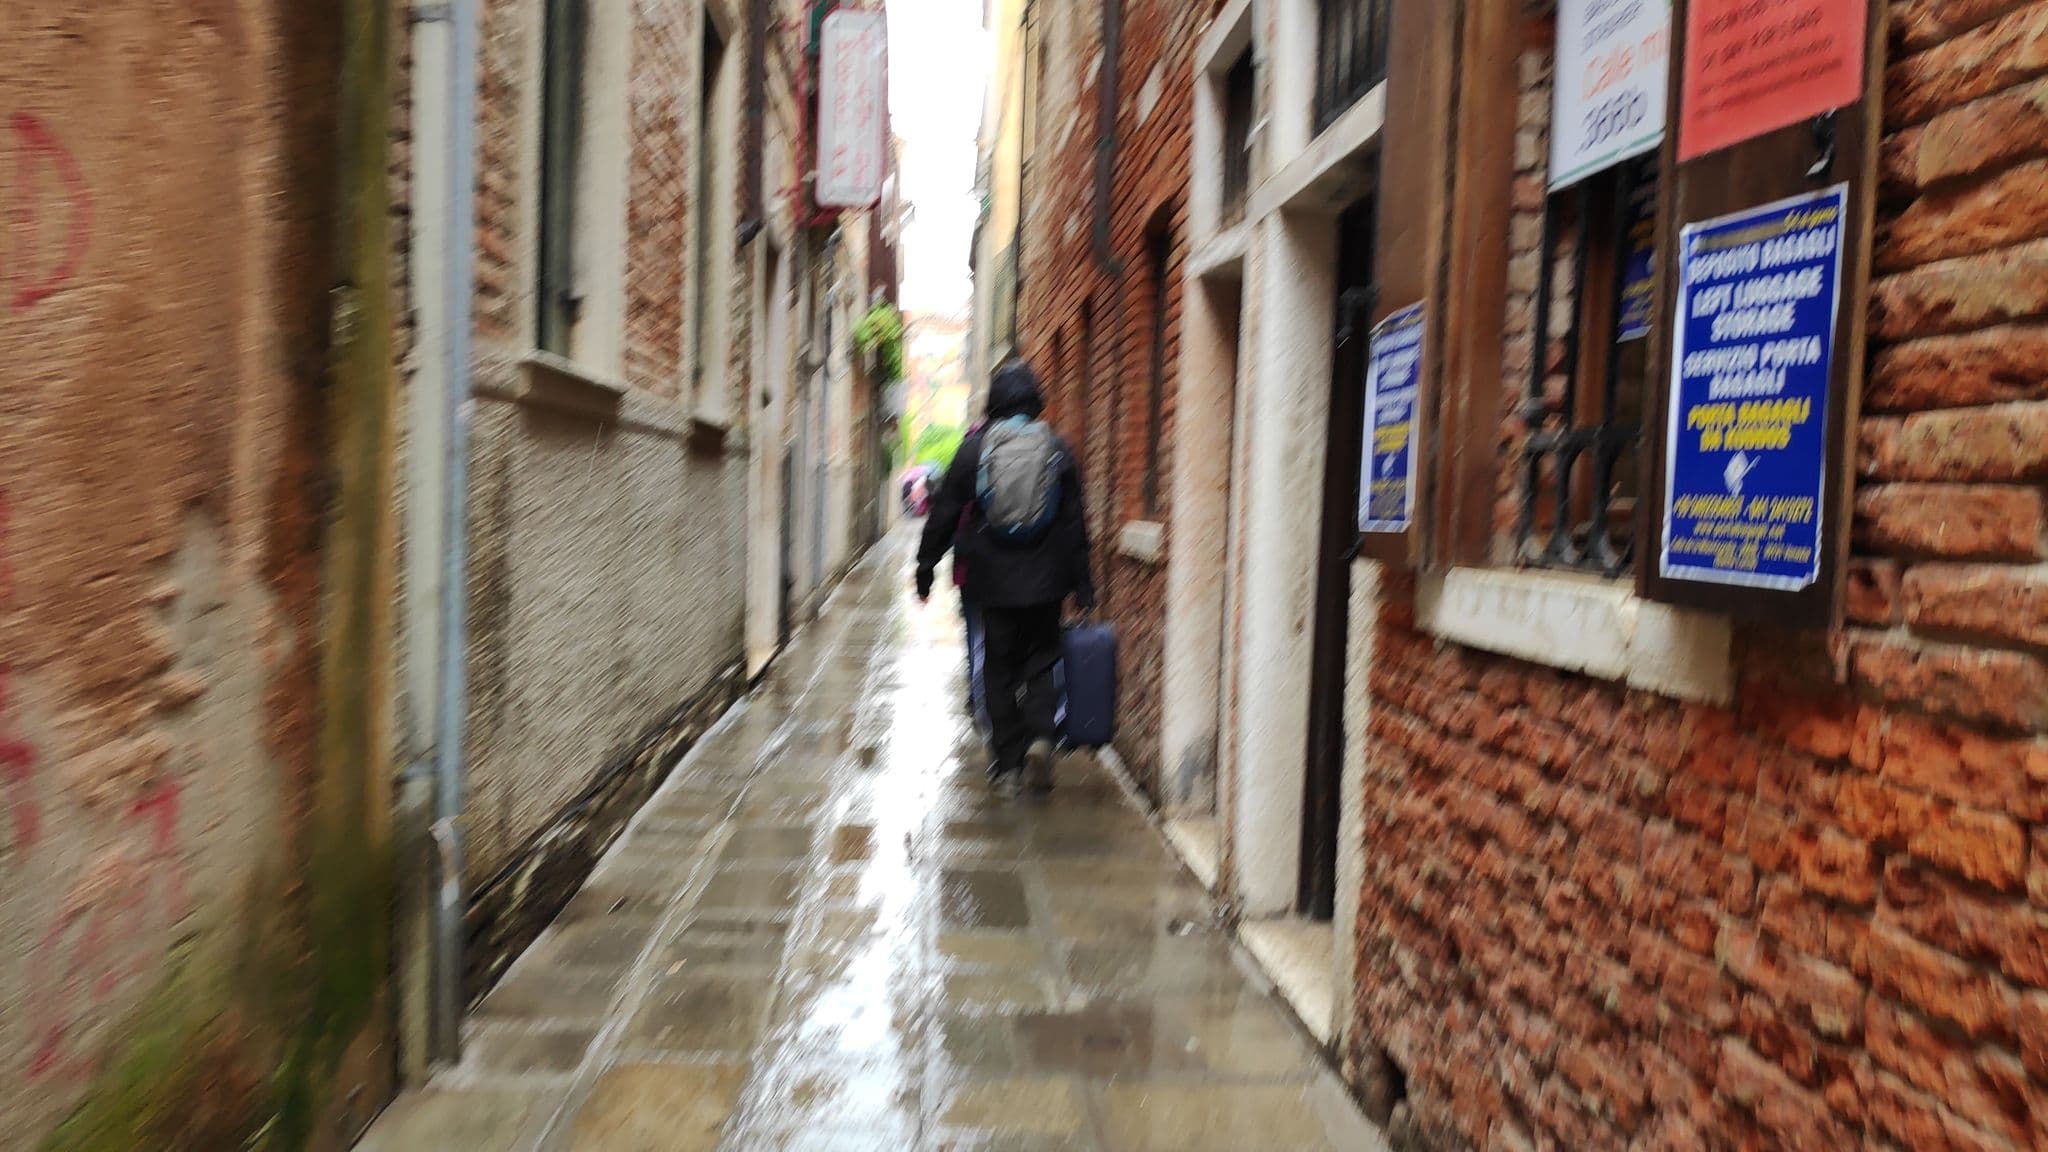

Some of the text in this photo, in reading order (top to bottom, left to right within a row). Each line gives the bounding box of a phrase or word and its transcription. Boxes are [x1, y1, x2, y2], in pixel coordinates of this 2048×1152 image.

[1688, 244, 1760, 284] DEPOSITO
[1760, 224, 1836, 269] BAGAGLI
[1692, 283, 1733, 318] LEFT
[1733, 264, 1823, 310] LUGGAGE
[1711, 301, 1796, 342] STORAGE
[1683, 335, 1822, 378] SERVIZIO PORTA
[1709, 368, 1786, 400] BAGAGLI
[1687, 396, 1811, 430] PORTA BAGAGLI
